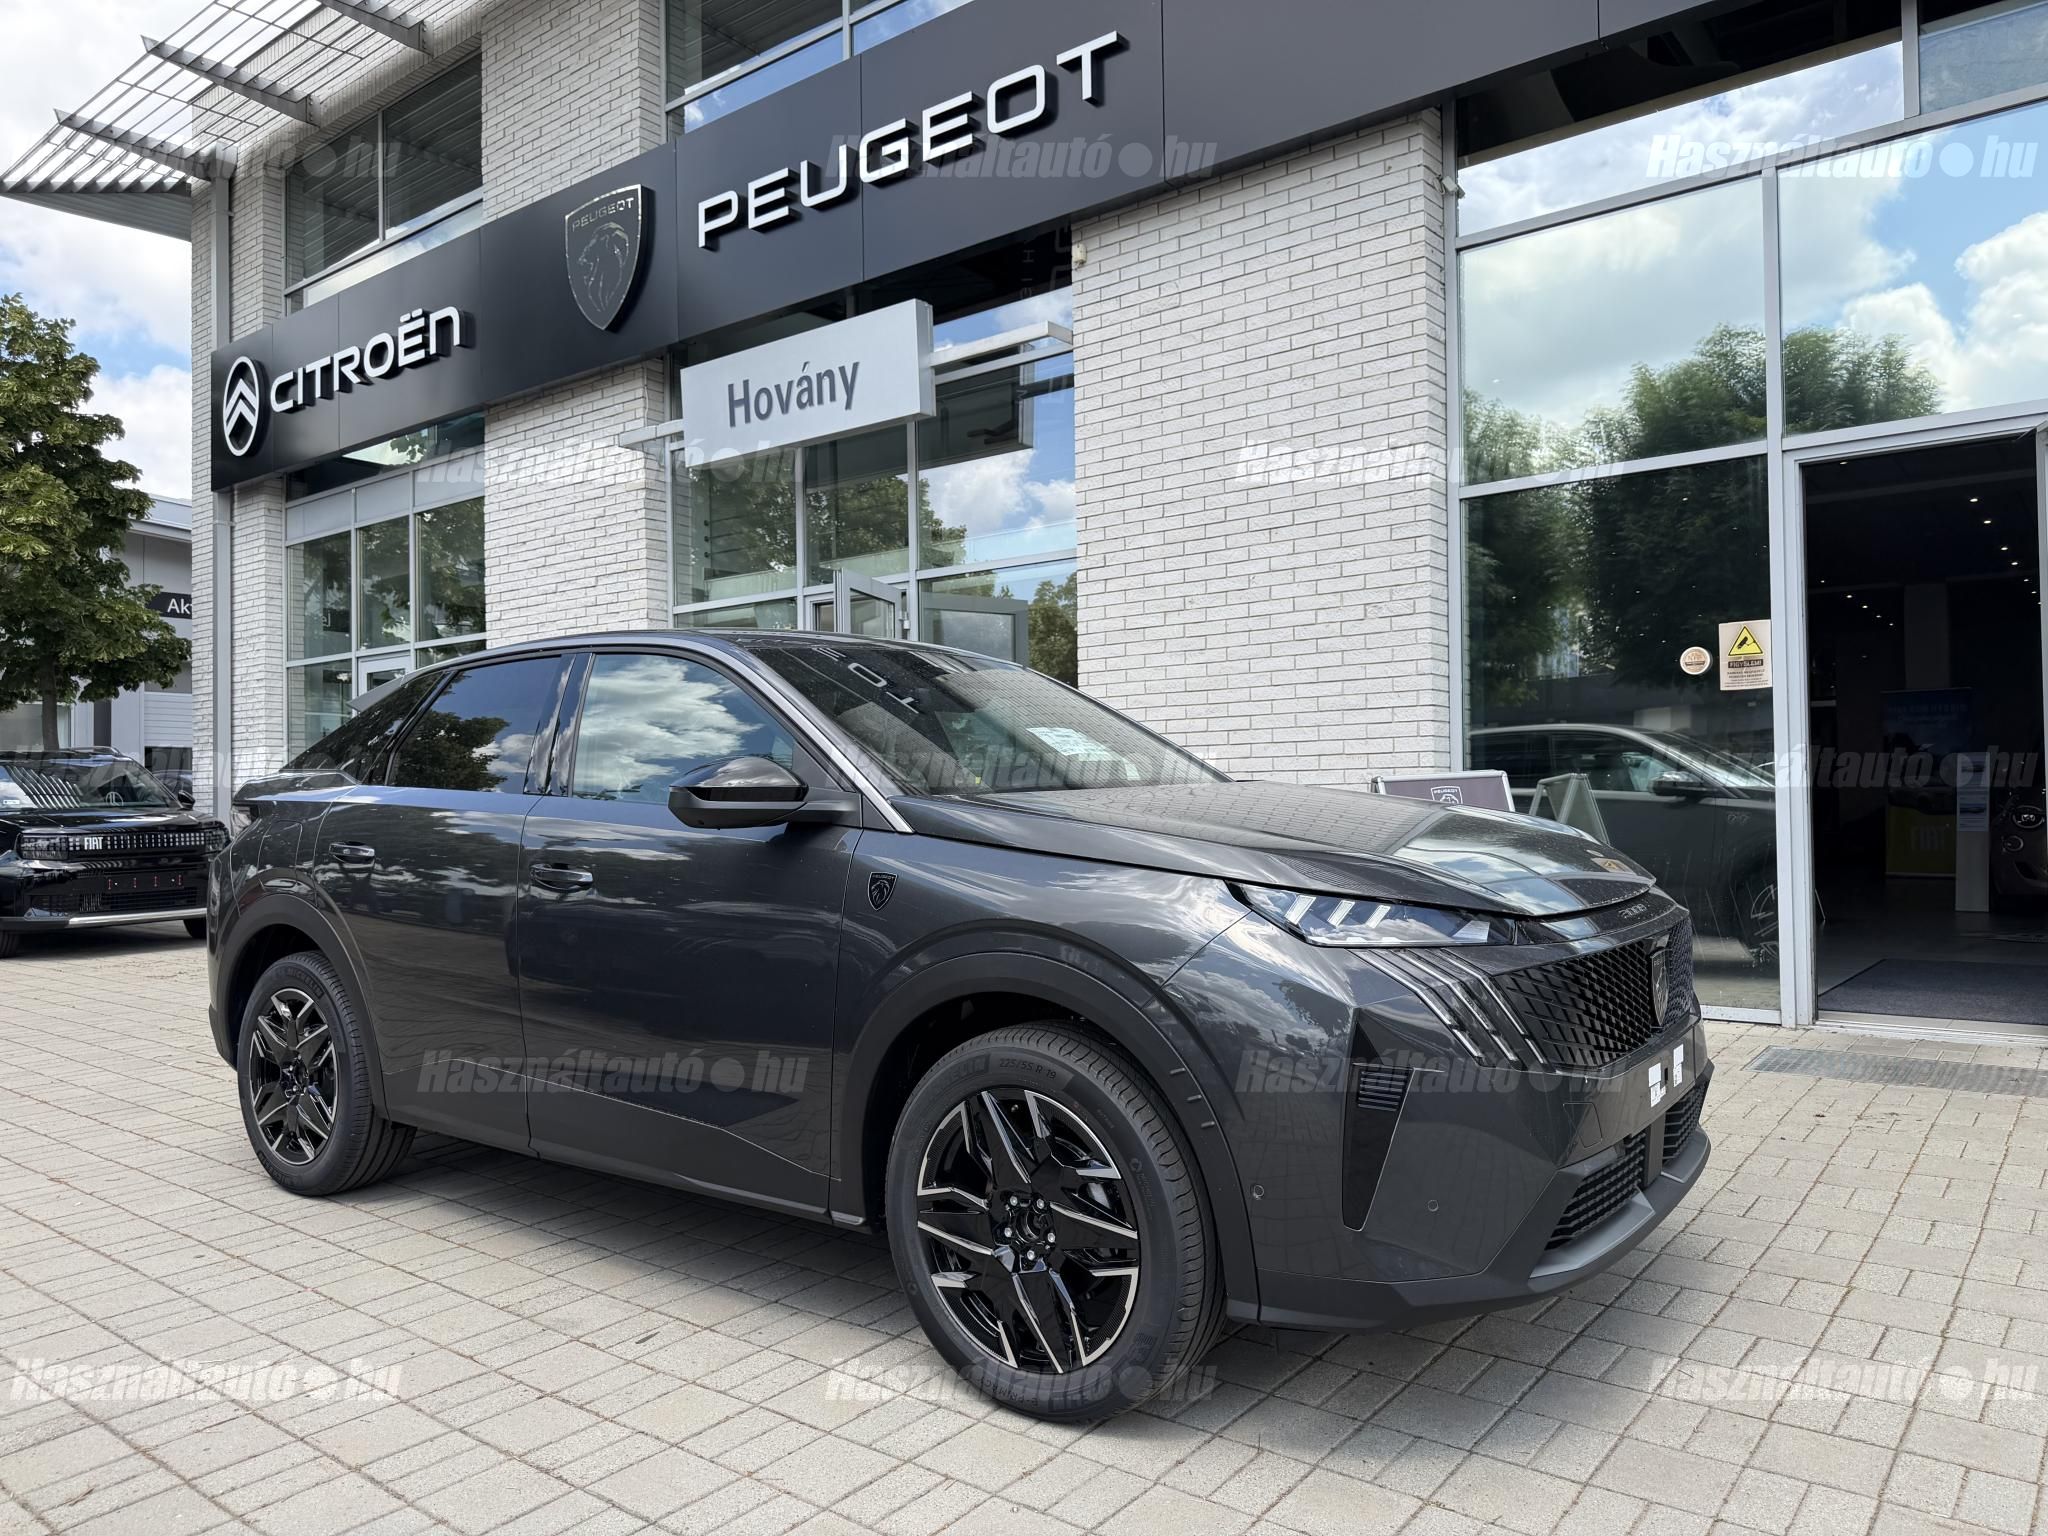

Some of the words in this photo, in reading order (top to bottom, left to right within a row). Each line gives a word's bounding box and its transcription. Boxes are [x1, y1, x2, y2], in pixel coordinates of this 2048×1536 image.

[698, 30, 1118, 248] PEUGEOT
[572, 197, 634, 232] PEUGEOT
[728, 361, 860, 427] Hovány
[167, 598, 192, 614] Ak
[84, 837, 103, 850] FIAT
[999, 1057, 1034, 1072] 225/55
[1035, 1063, 1043, 1074] R
[1046, 1069, 1057, 1079] 19
